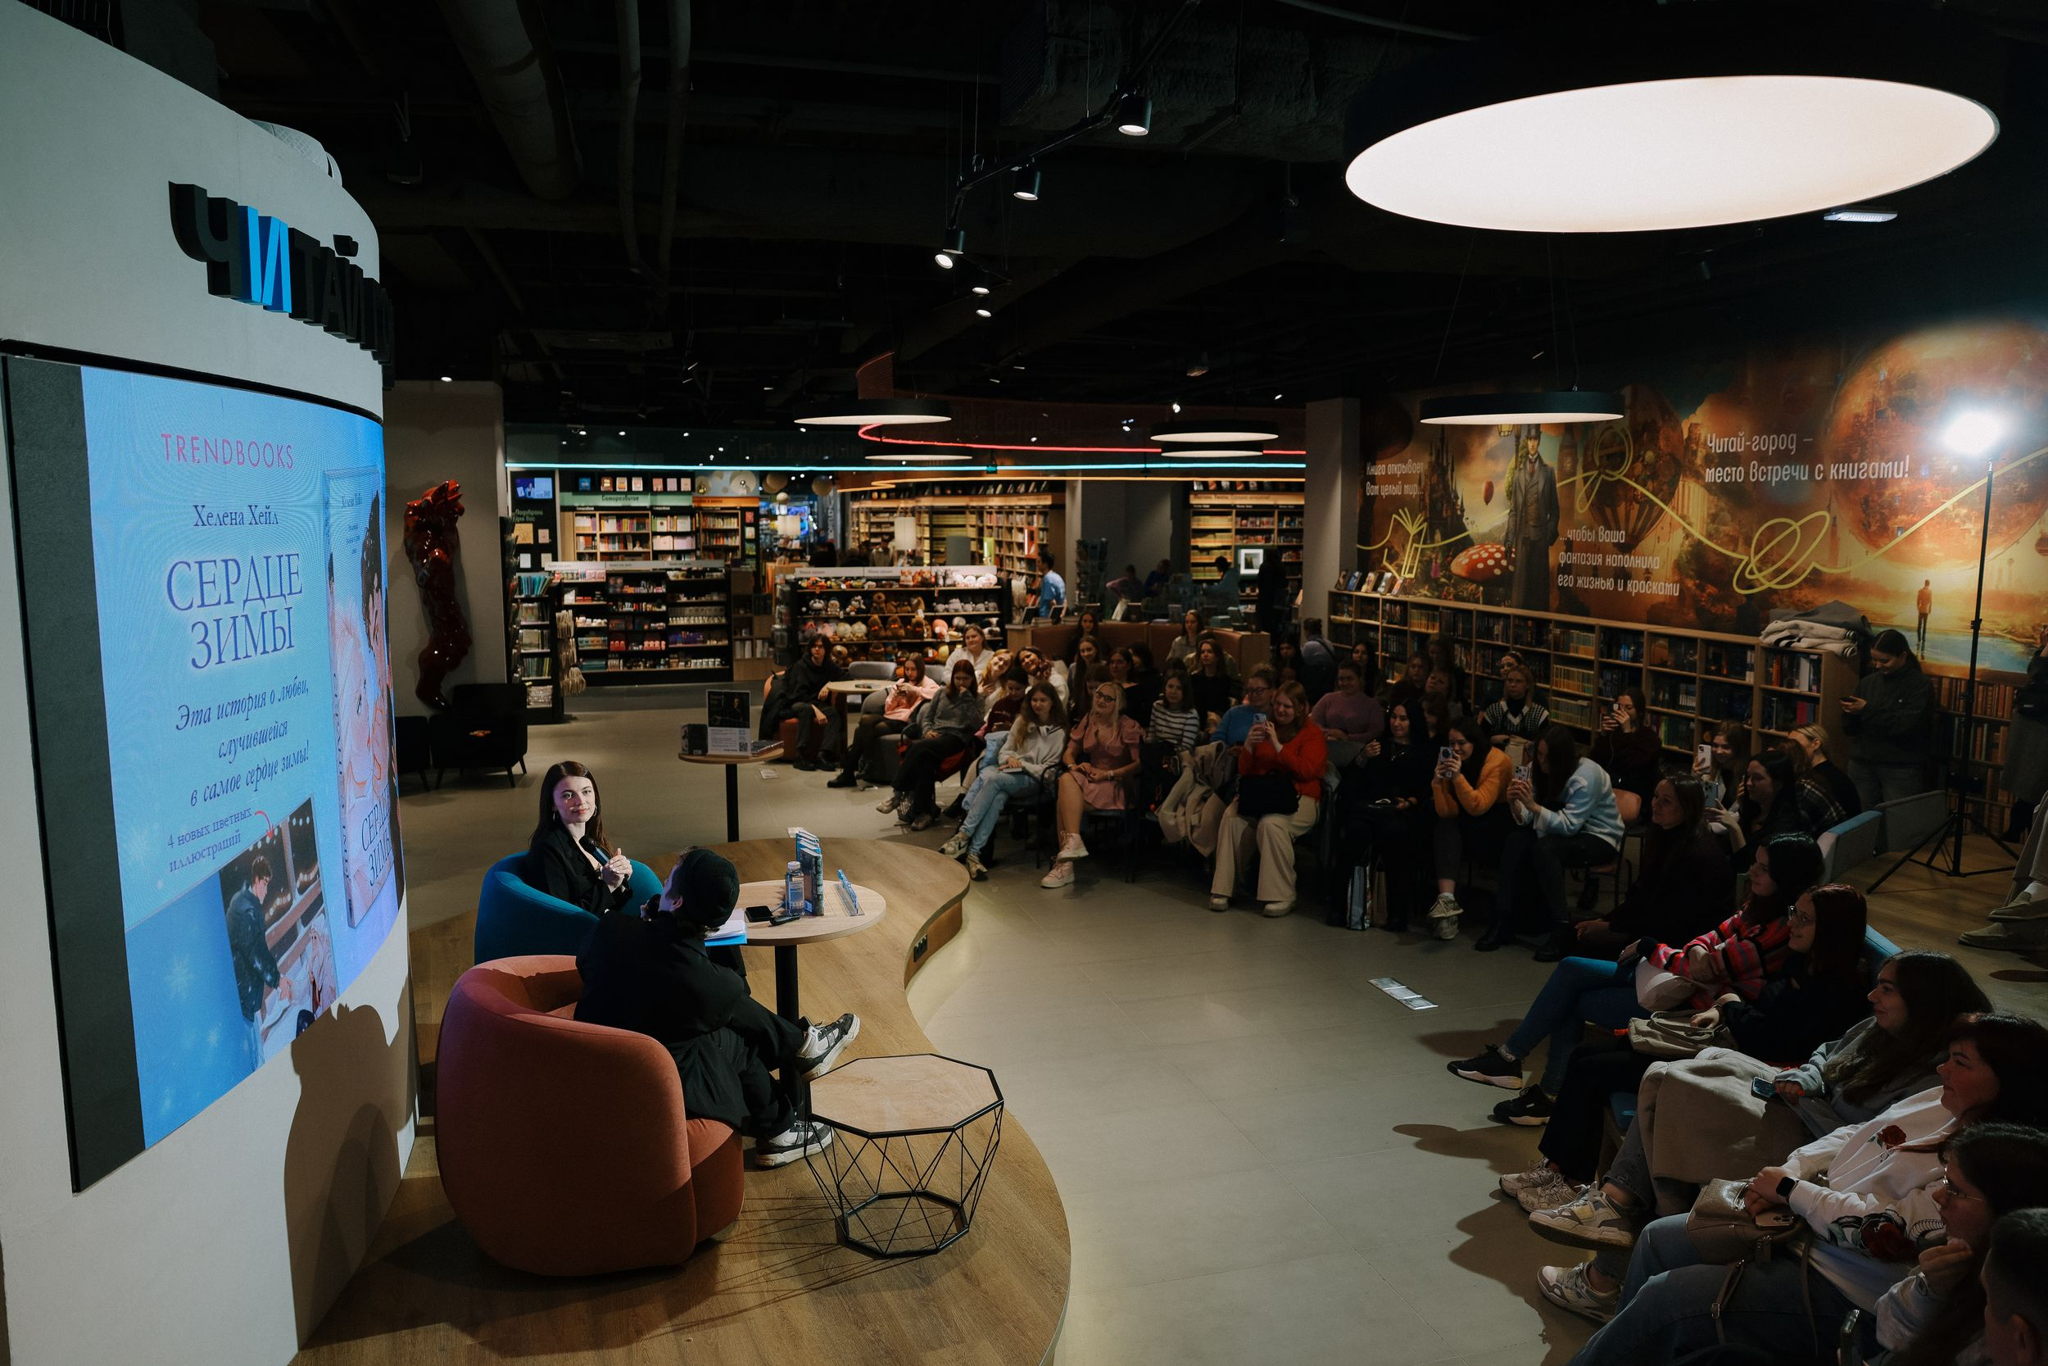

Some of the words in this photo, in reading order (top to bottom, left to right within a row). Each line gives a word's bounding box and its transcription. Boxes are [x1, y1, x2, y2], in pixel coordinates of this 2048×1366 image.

[161, 433, 294, 469] TRENDBOOKS
[1707, 431, 1798, 455] Читай-город
[1705, 466, 1745, 483] место
[1815, 463, 1824, 480] с
[1829, 455, 1910, 480] книгами!
[193, 504, 245, 527] Хелена
[248, 505, 279, 525] Хейл
[166, 553, 303, 611] СЕРДЦЕ
[1606, 553, 1660, 569] наполнила
[1558, 574, 1574, 587] его
[1576, 576, 1614, 591] жизнью
[1617, 579, 1624, 591] и
[1626, 579, 1680, 597] красками
[191, 606, 295, 669] ЗИМЫ
[176, 704, 212, 731] Эта
[217, 691, 267, 721] история
[269, 689, 275, 705] о
[278, 675, 309, 702] любви,
[218, 720, 288, 764] случившейся
[190, 789, 198, 807] в
[203, 774, 241, 802] самое
[245, 757, 279, 792] сердце
[281, 738, 309, 773] зимы!
[167, 833, 175, 849] 4
[177, 824, 211, 846] новых
[212, 807, 253, 833] цветных
[169, 829, 241, 873] иллюстраций
